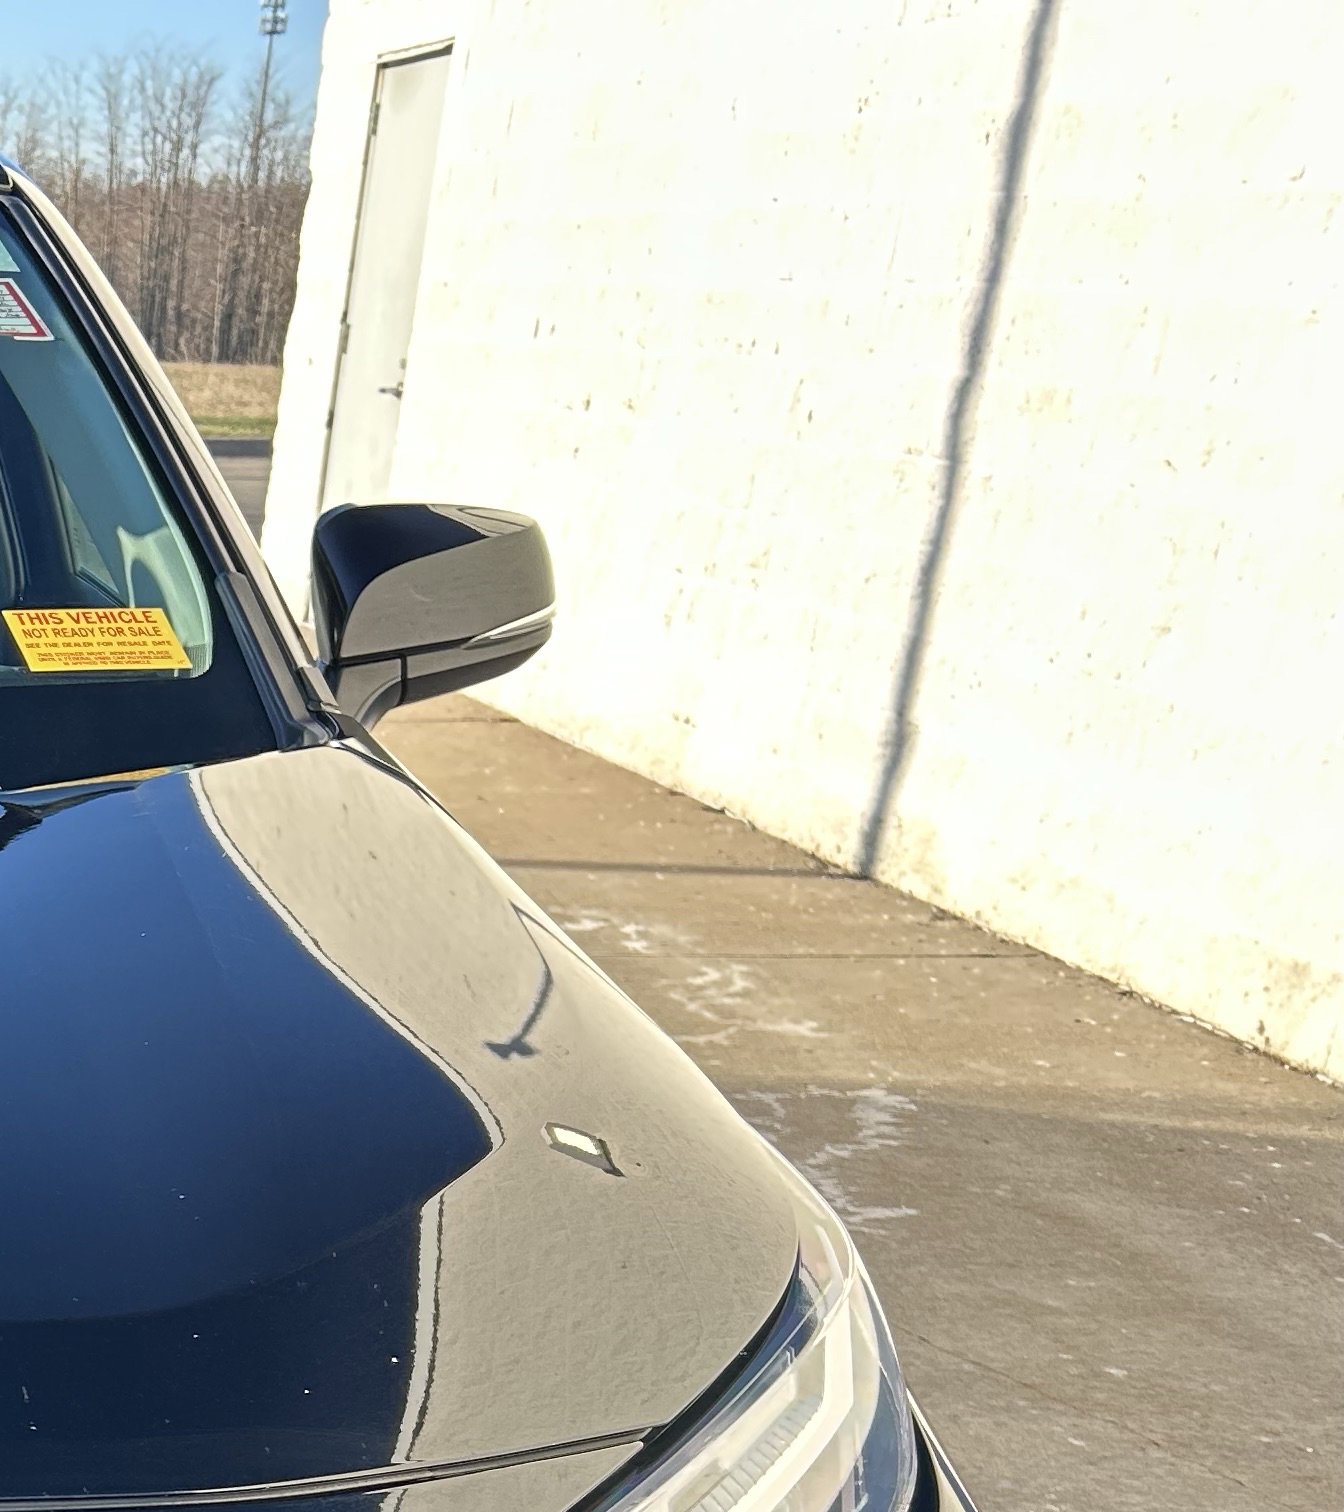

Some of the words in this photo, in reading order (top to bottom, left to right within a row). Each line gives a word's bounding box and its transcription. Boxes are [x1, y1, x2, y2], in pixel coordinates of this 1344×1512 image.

[11, 612, 64, 626] THIS
[65, 610, 158, 625] VEHICLE
[21, 628, 53, 639] NOT
[52, 627, 97, 638] READY
[97, 626, 126, 638] FOR
[129, 626, 164, 637] SALE
